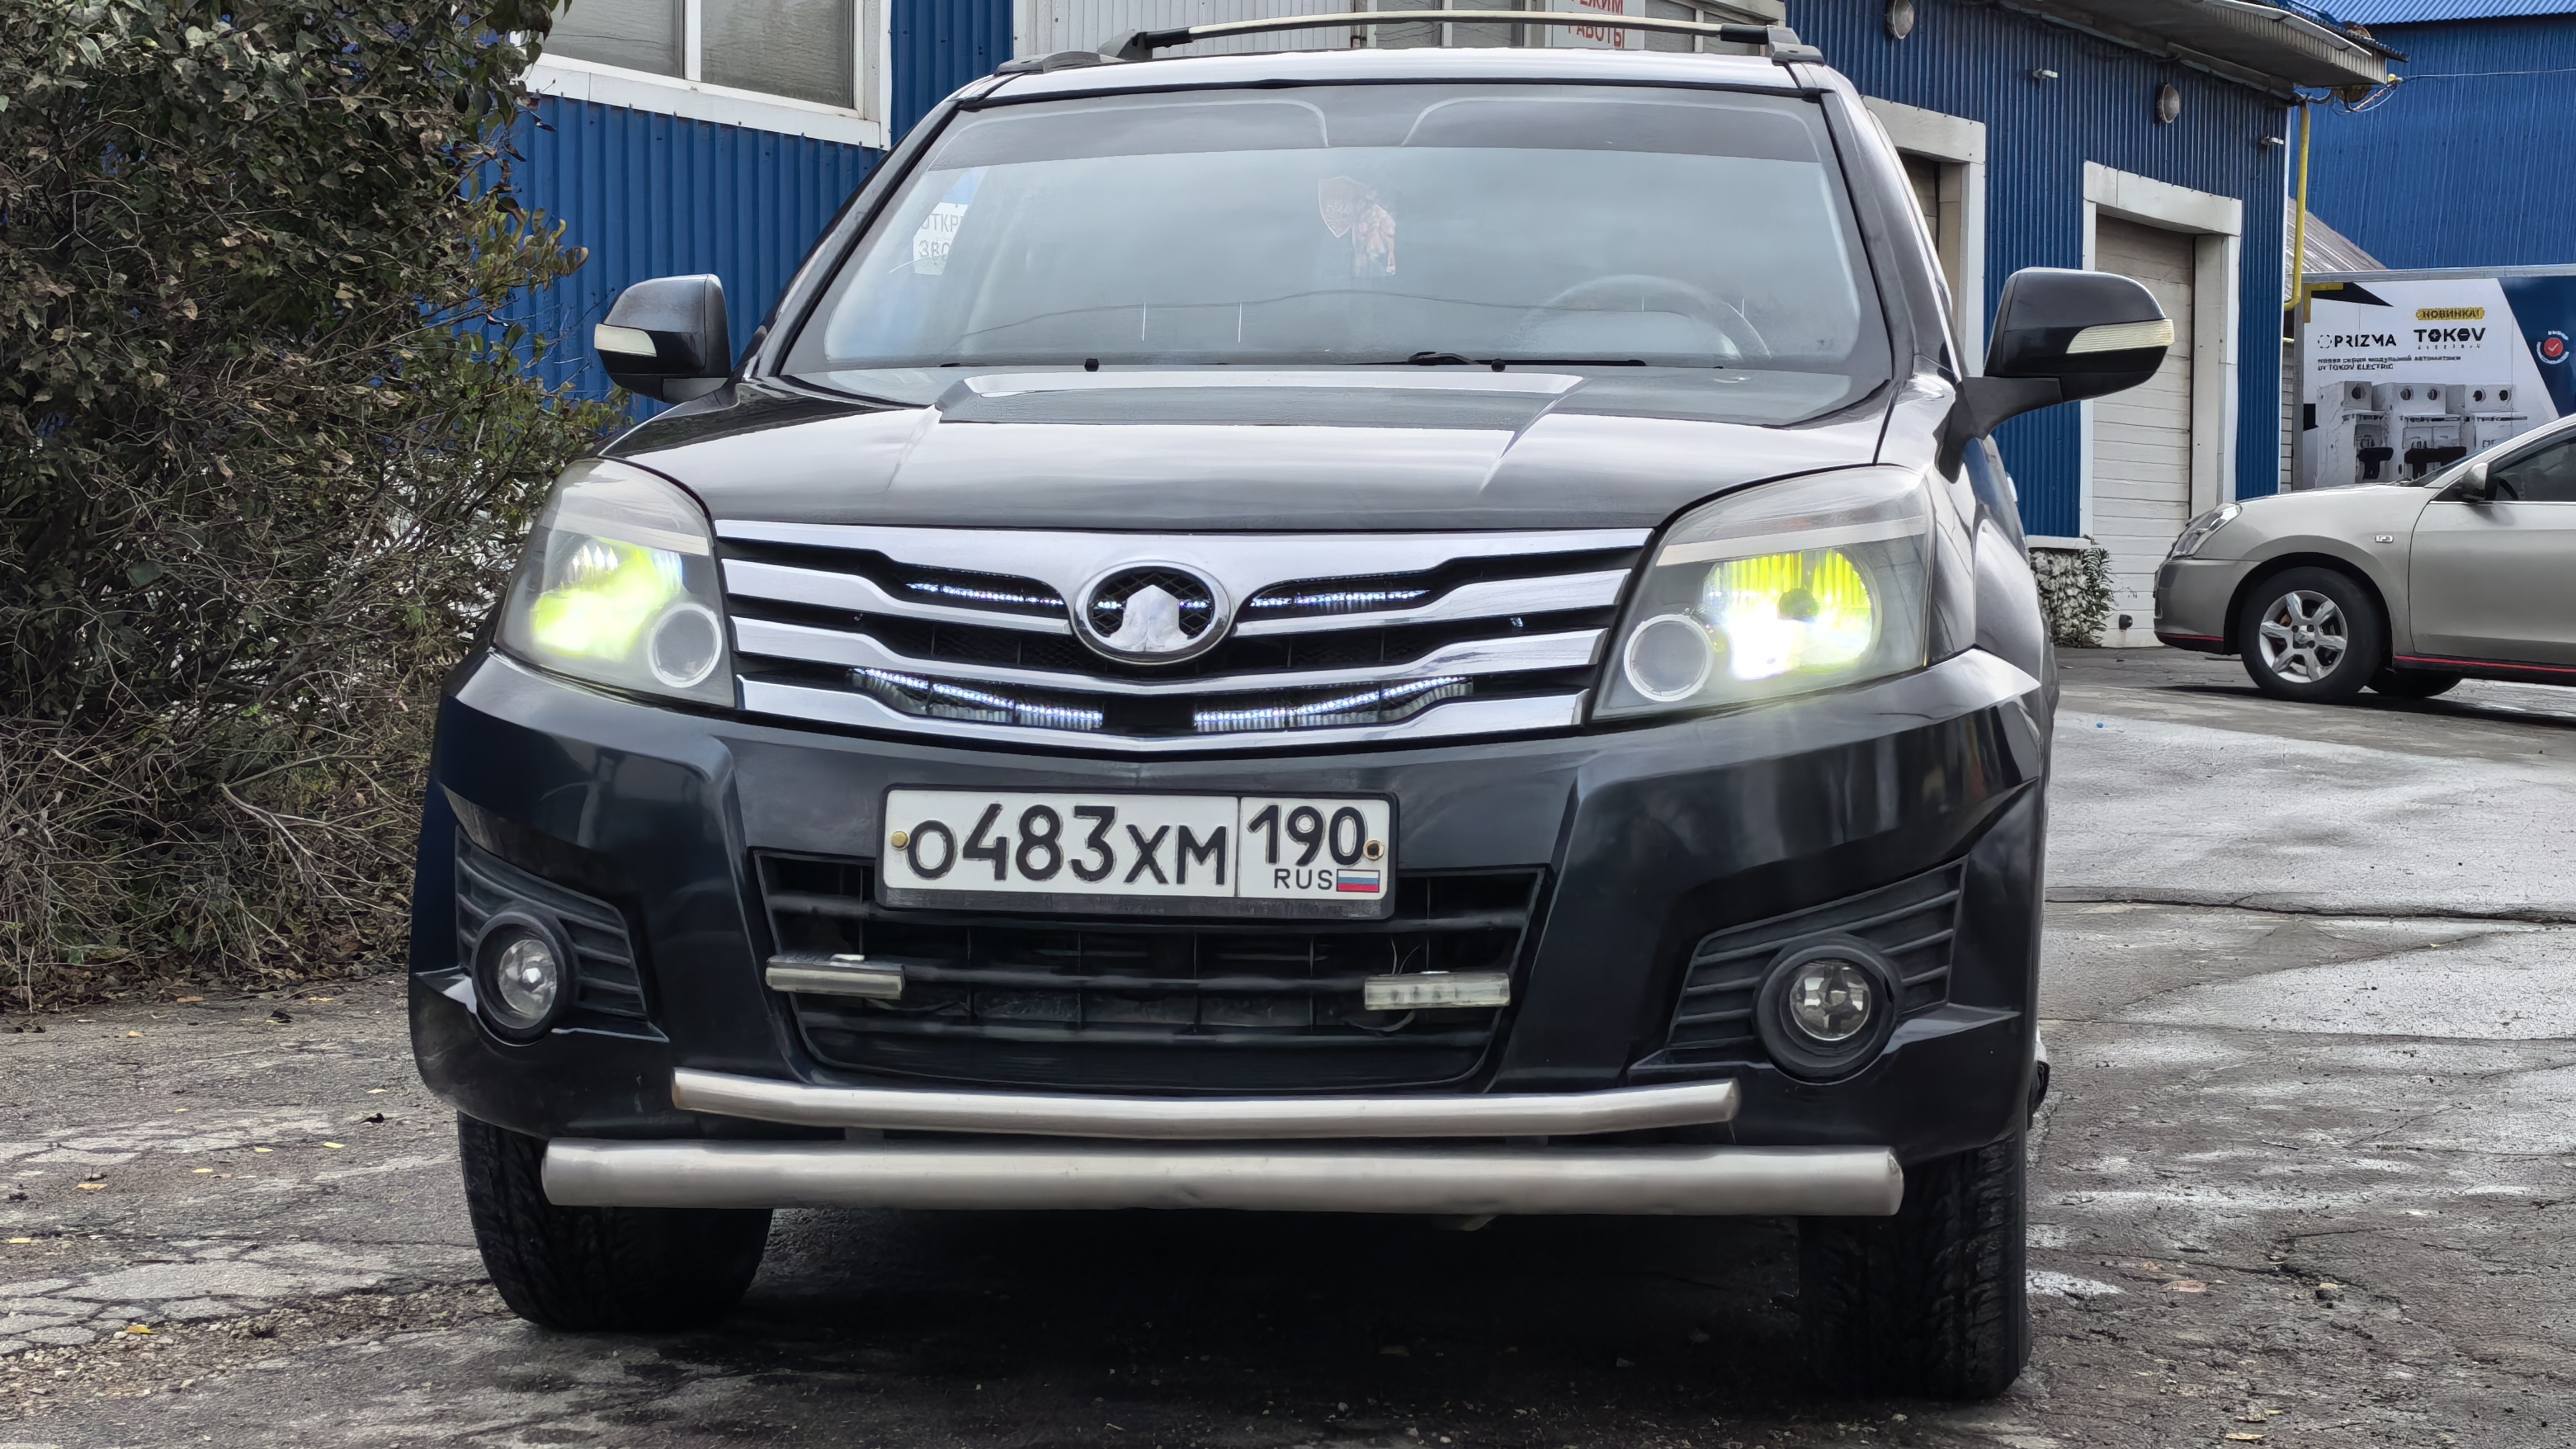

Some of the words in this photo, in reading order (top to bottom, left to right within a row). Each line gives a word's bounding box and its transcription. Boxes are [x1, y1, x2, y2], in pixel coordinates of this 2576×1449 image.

[1571, 0, 1623, 15] ЕЖИМ
[2334, 333, 2397, 347] PRIZMA
[2413, 327, 2486, 342] TOKOV
[908, 803, 1226, 885] О483ХМ
[1247, 805, 1366, 866] 190
[1274, 869, 1333, 890] RUS
